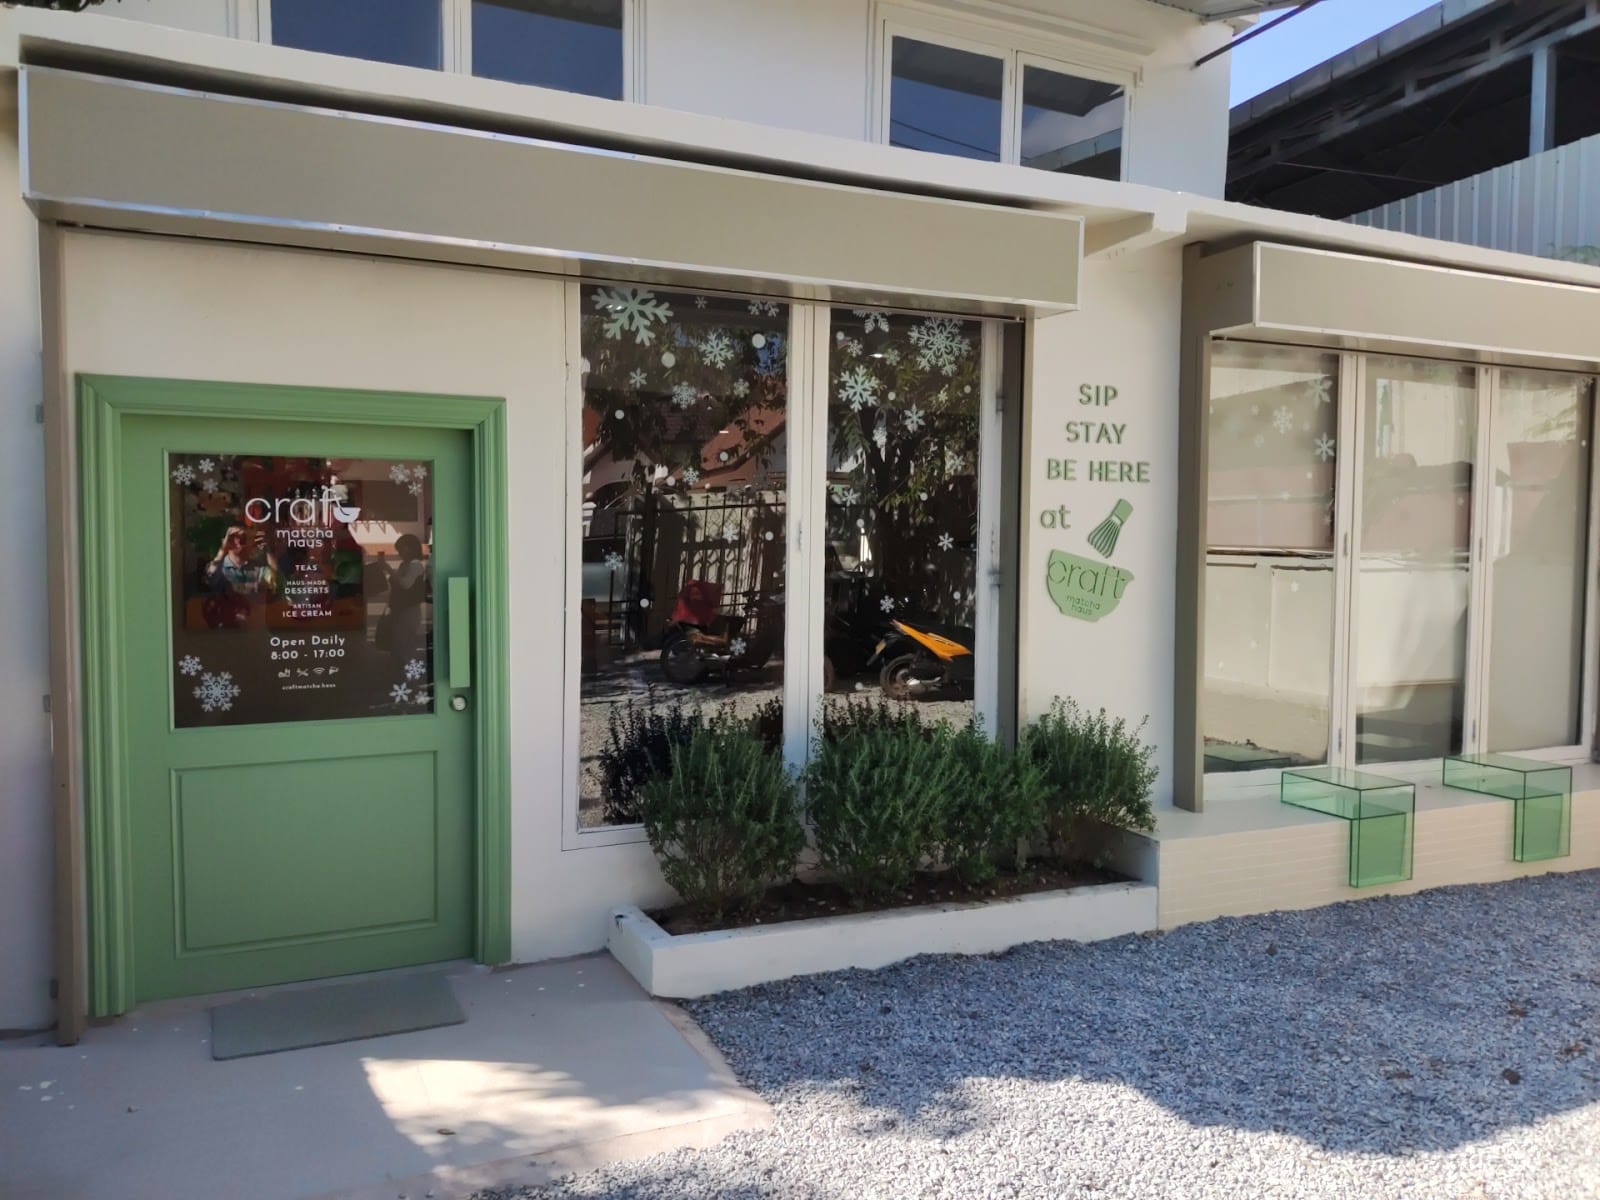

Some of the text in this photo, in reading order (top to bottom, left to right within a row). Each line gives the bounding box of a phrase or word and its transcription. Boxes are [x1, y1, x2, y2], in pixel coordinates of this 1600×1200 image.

[1078, 383, 1118, 406] SIP
[1066, 421, 1127, 444] STAY
[1047, 458, 1151, 483] BE HERE
[1040, 504, 1071, 529] at
[277, 529, 333, 539] matcha
[287, 536, 323, 548] haus
[295, 564, 318, 572] TEAS
[284, 586, 329, 595] DESSERTS
[282, 609, 332, 618] ICE CREAM
[270, 634, 345, 649] Open Daily
[270, 650, 299, 660] 8:00
[313, 648, 345, 659] 17:00
